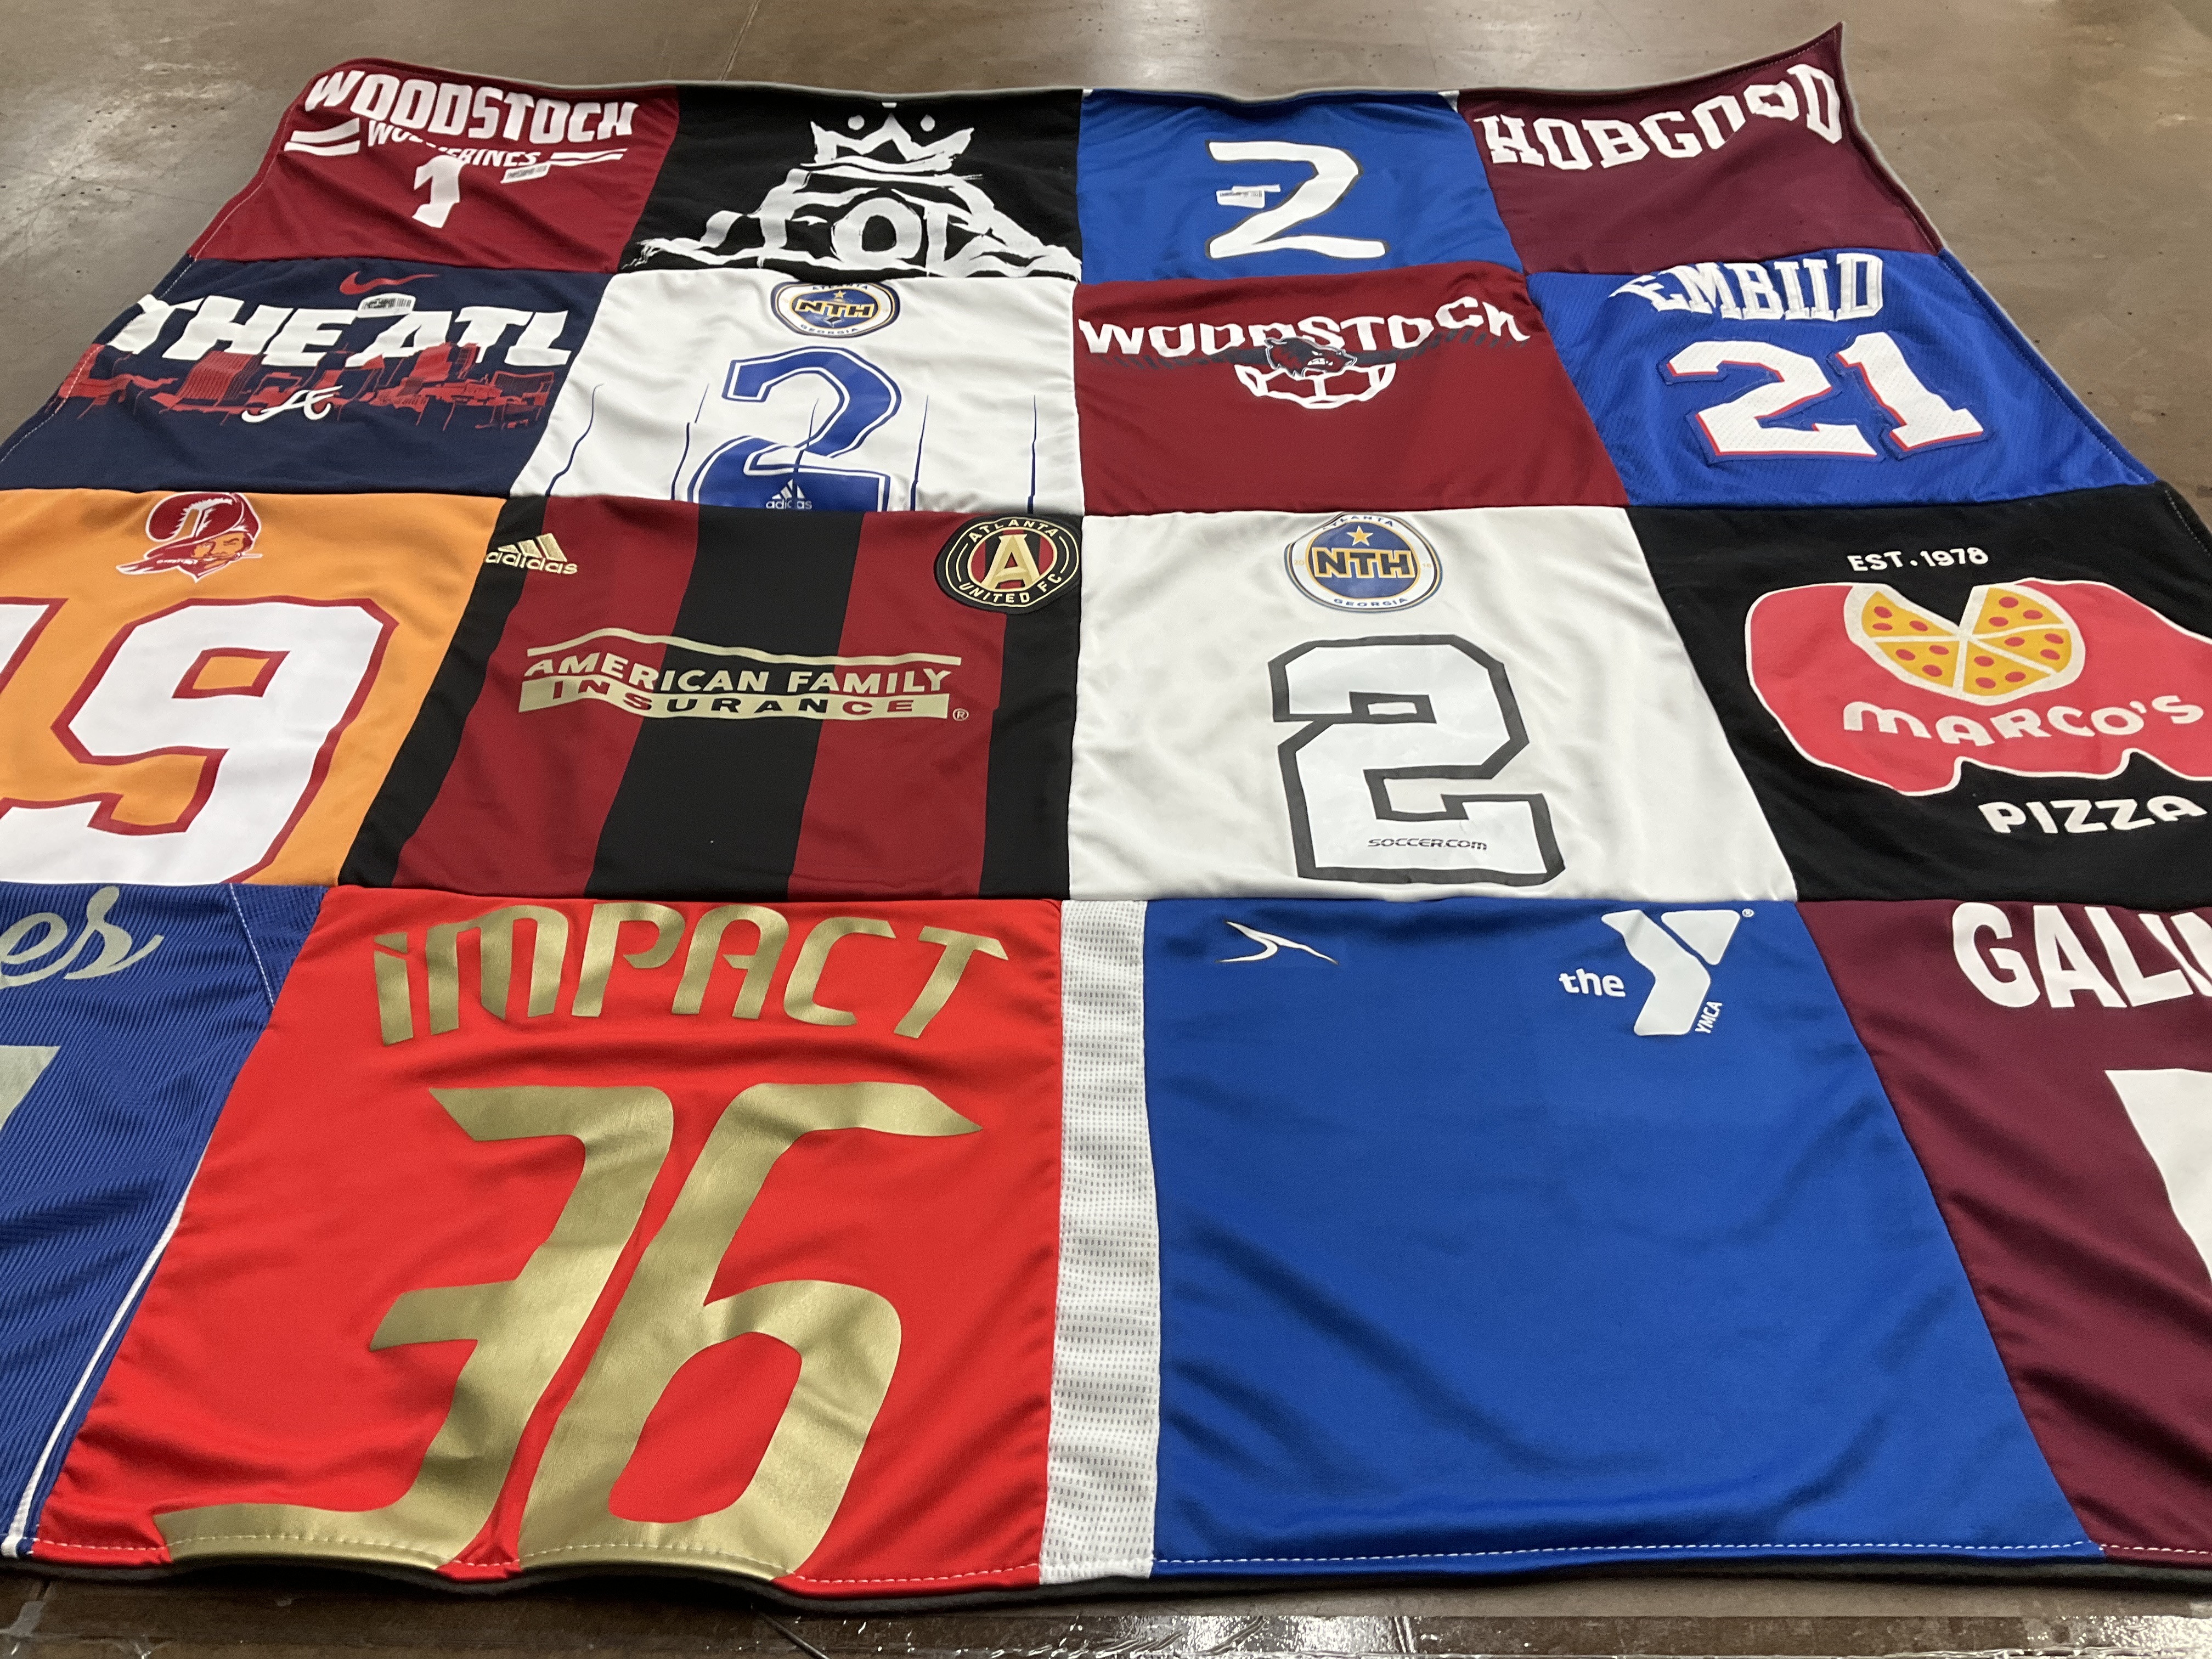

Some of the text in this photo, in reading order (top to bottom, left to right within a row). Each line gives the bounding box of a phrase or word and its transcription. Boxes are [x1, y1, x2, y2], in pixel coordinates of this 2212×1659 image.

[304, 70, 639, 144] WOODSTOCK
[1474, 63, 1843, 171] HOBGOOD
[413, 155, 465, 228] 1
[1207, 140, 1390, 259] 2
[1609, 252, 1883, 321] EMBIID
[795, 298, 874, 318] NTH
[107, 294, 572, 368] THE ATL
[1662, 330, 1987, 456] 21
[688, 346, 902, 511] 2
[968, 519, 1059, 543] ATLANTA
[485, 551, 578, 574] adidas
[1312, 547, 1416, 579] NTH
[1920, 547, 1989, 567] 1978
[959, 573, 1062, 603] UNITED FC
[1334, 597, 1408, 607] GEORGIA
[523, 652, 952, 695] AMERICAN FAMILY
[552, 681, 915, 715] INSURANCE
[1268, 634, 1566, 887] 2
[1978, 795, 2208, 834] PIZZA
[1559, 968, 1626, 997] the
[1695, 1001, 1723, 1034] YMCA
[154, 1081, 984, 1581] 36
